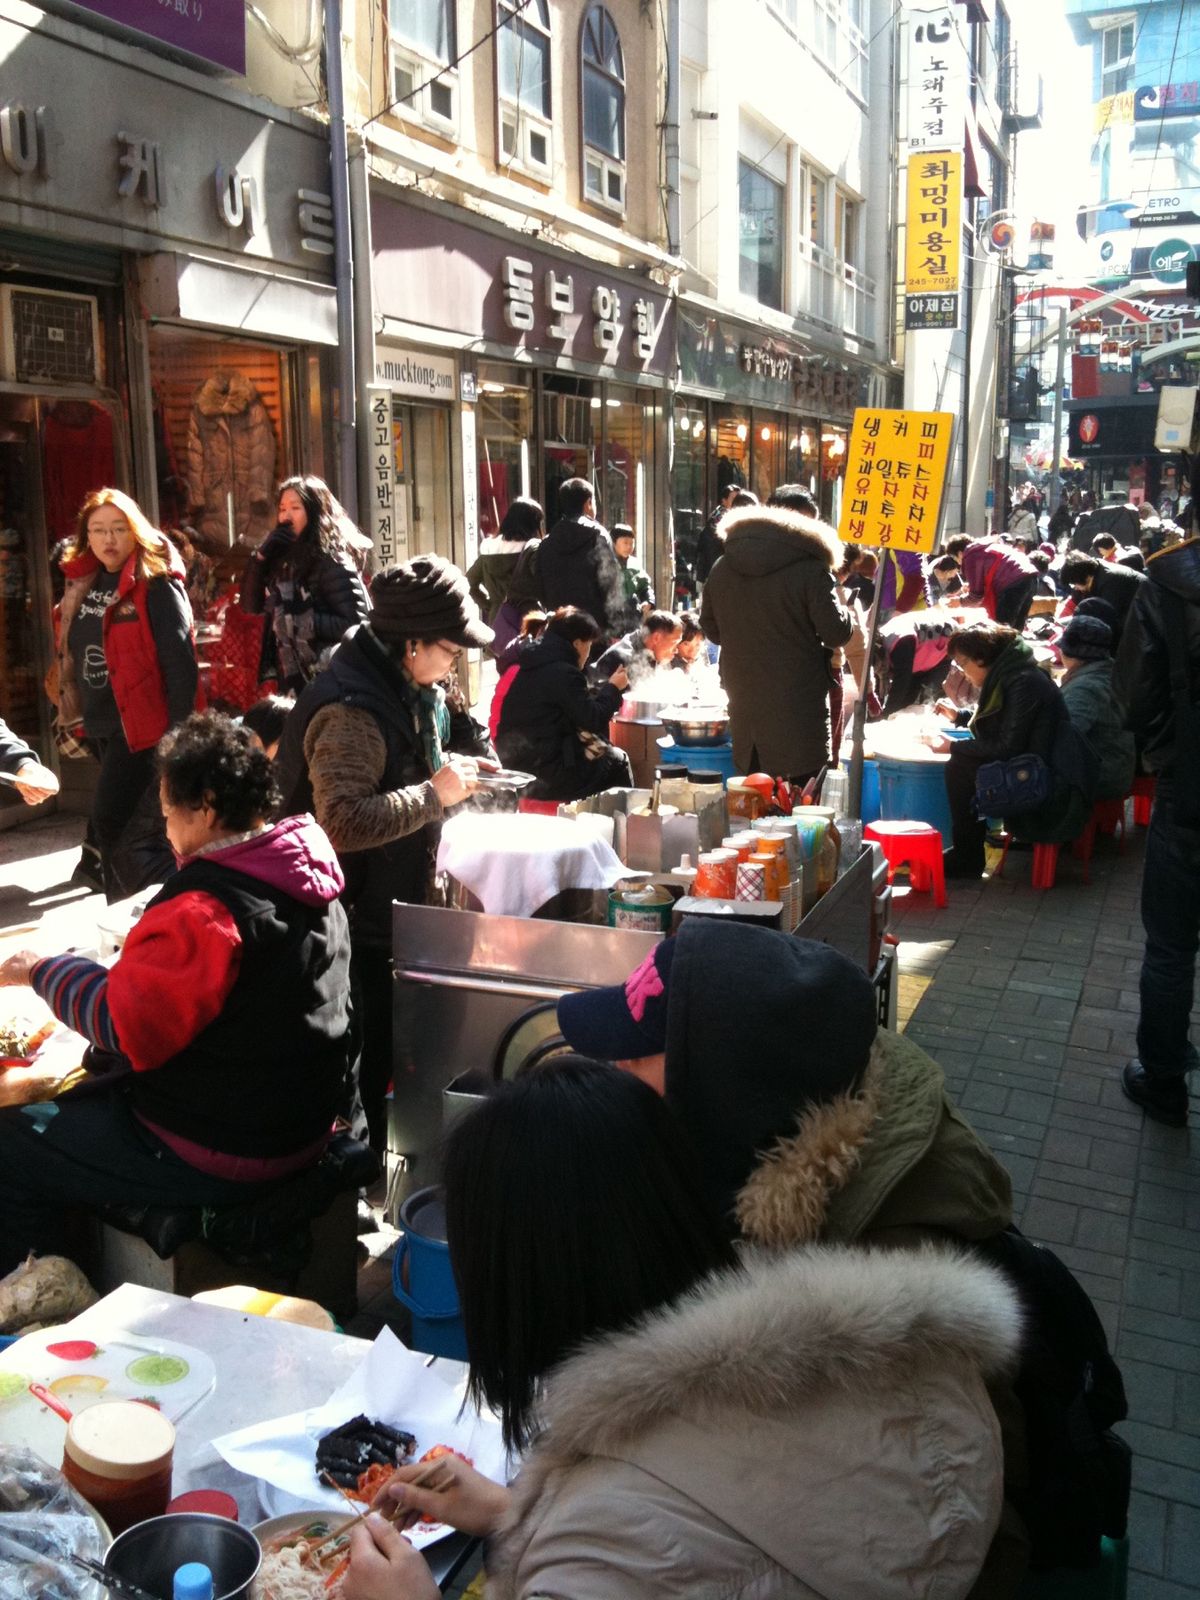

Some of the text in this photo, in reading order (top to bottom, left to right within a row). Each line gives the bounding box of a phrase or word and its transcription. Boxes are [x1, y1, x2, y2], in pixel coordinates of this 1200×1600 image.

[921, 56, 948, 136] 노래주점
[503, 256, 655, 359] 동부양행
[863, 417, 938, 439] 냉커피
[862, 440, 935, 460] 커피
[856, 477, 929, 501] 유자차
[850, 499, 925, 522] 대추차
[849, 519, 922, 545] 생강차
